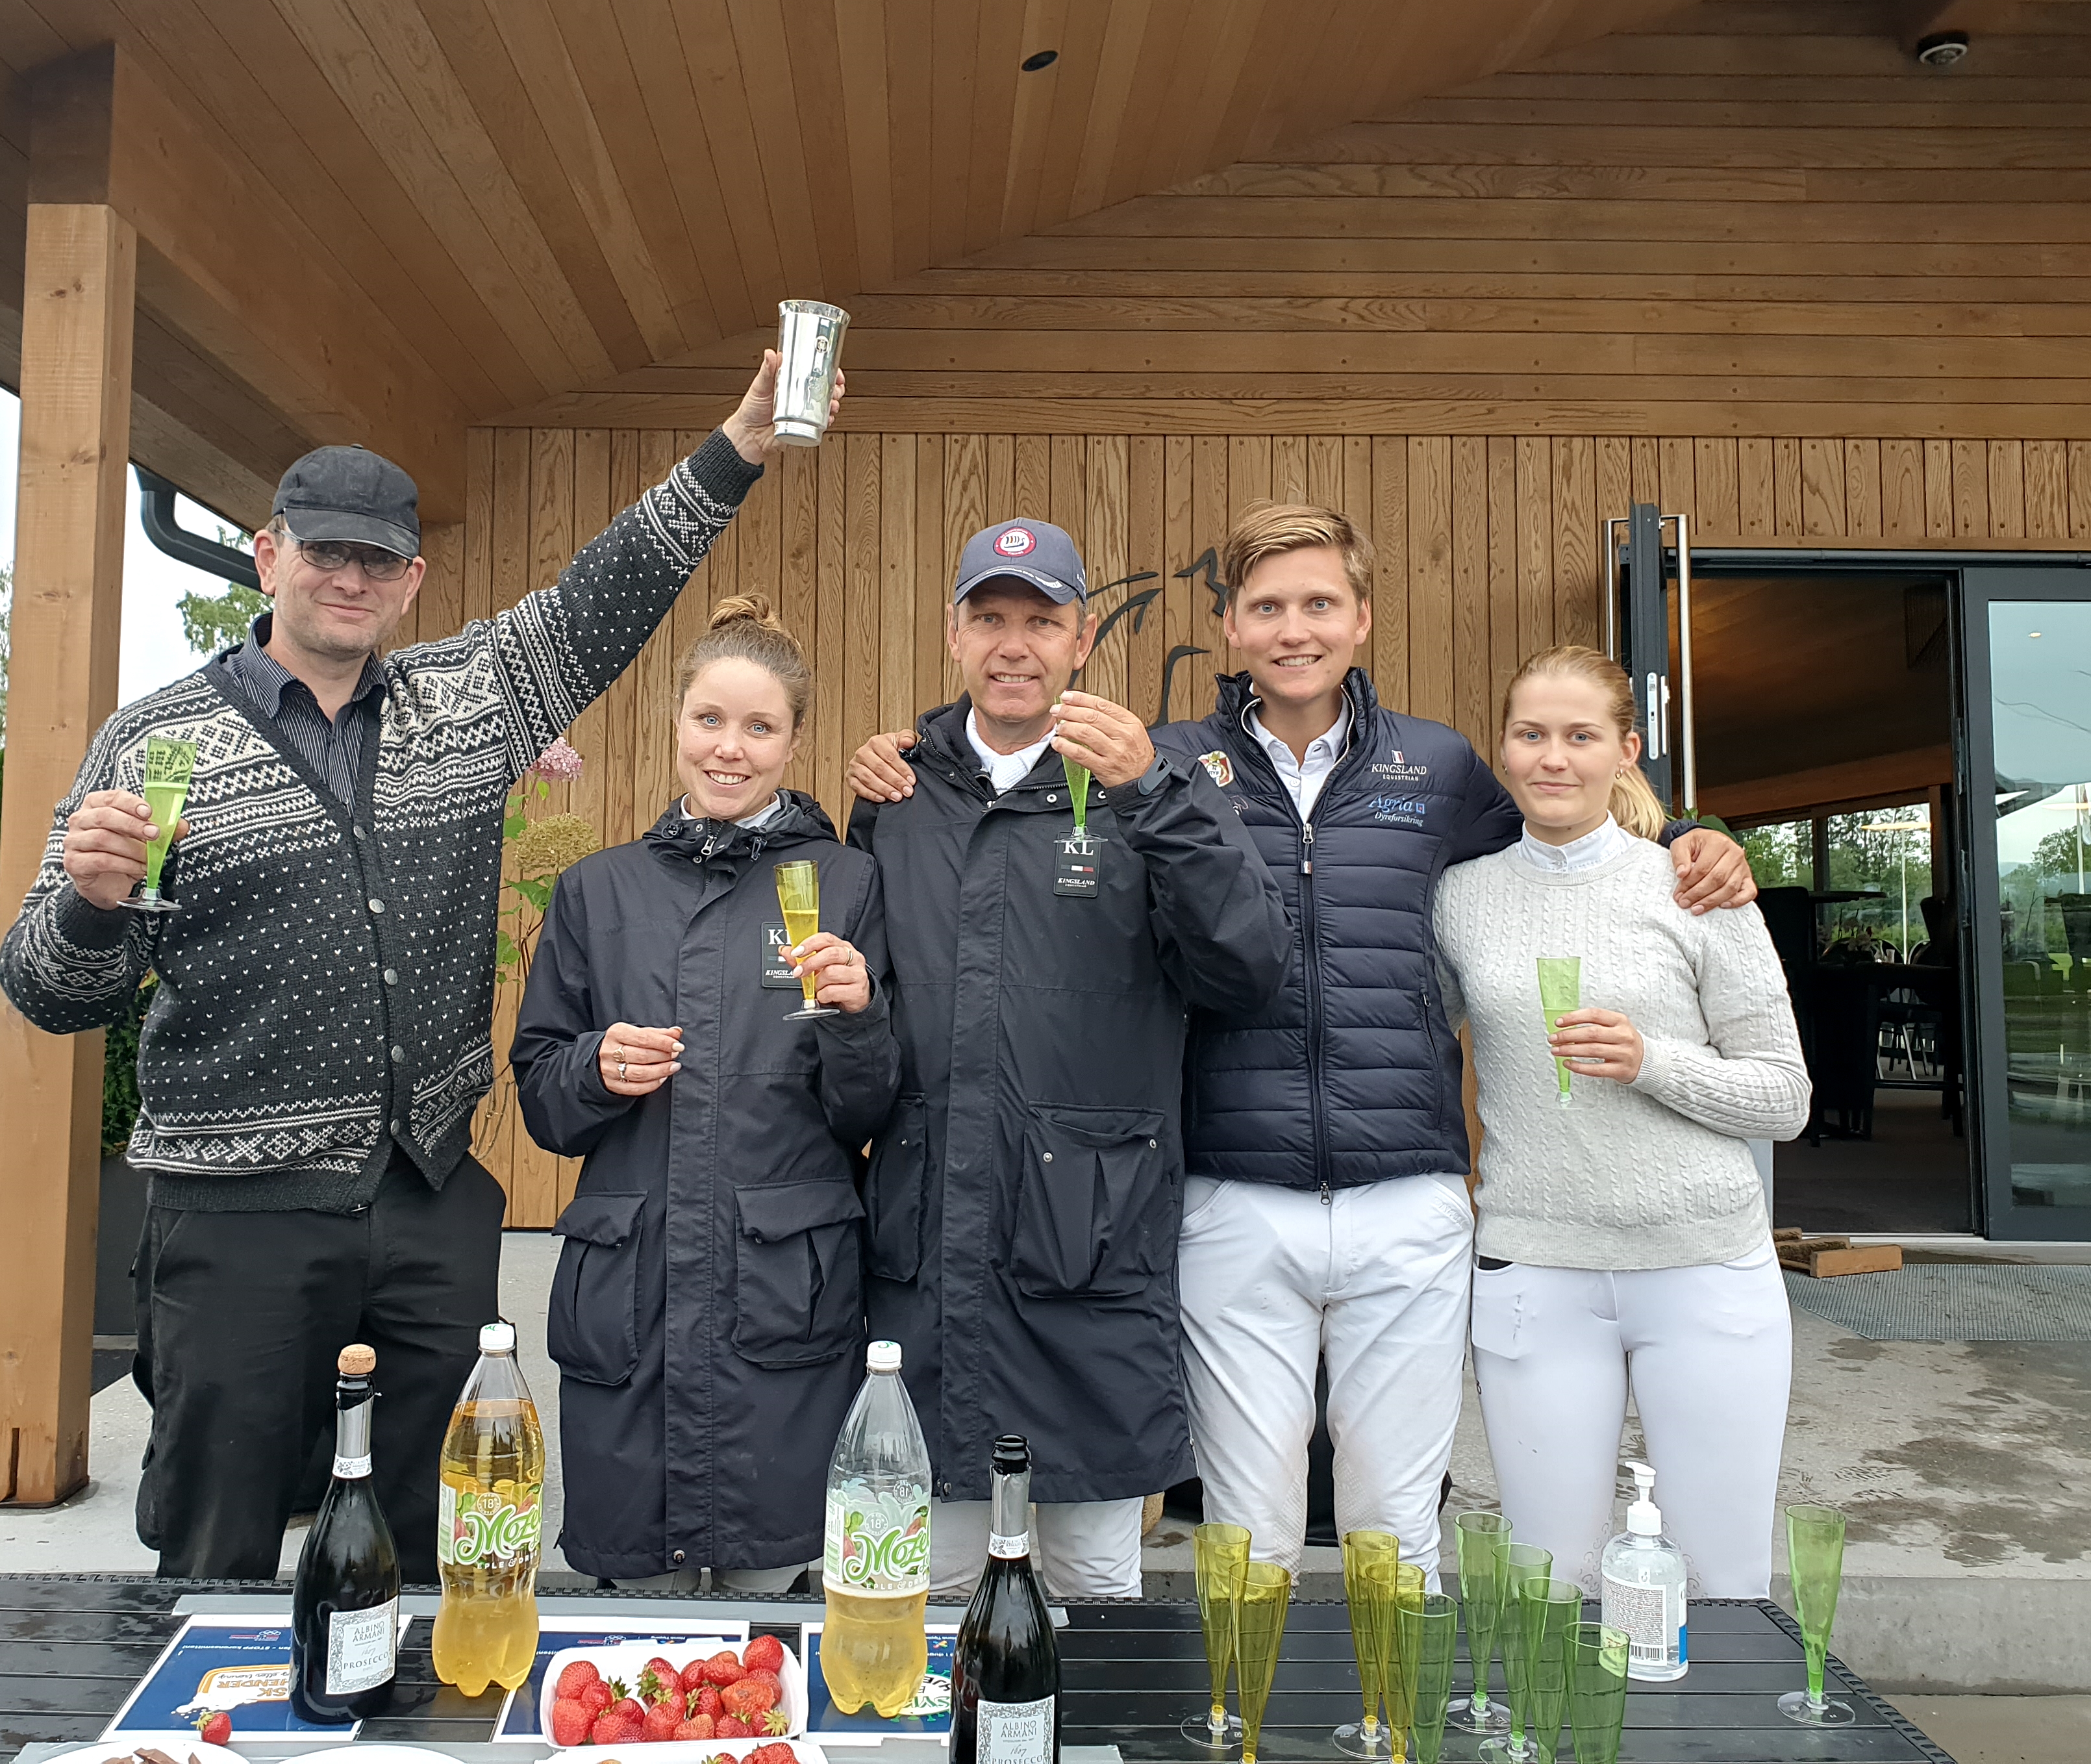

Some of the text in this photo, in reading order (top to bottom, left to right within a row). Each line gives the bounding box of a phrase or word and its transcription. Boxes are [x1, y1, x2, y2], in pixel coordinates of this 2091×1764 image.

[1371, 763, 1427, 775] KINGSLAND
[1368, 794, 1413, 814] Agria
[1374, 811, 1424, 827] Dyreforsikring
[1063, 840, 1094, 856] KL
[1057, 877, 1096, 886] KINGSLAND
[477, 1561, 505, 1570] EPLE
[508, 1558, 517, 1567] &
[897, 1581, 907, 1589] &
[354, 1620, 384, 1635] ALBINO
[352, 1628, 385, 1643] ARMANI
[344, 1651, 388, 1670] PROSECCO
[257, 1687, 288, 1697] SK
[1002, 1720, 1037, 1730] ALBINO
[1001, 1728, 1037, 1738] ARMANI
[1010, 1744, 1027, 1756] 1607
[992, 1754, 1043, 1764] PROSECCO
